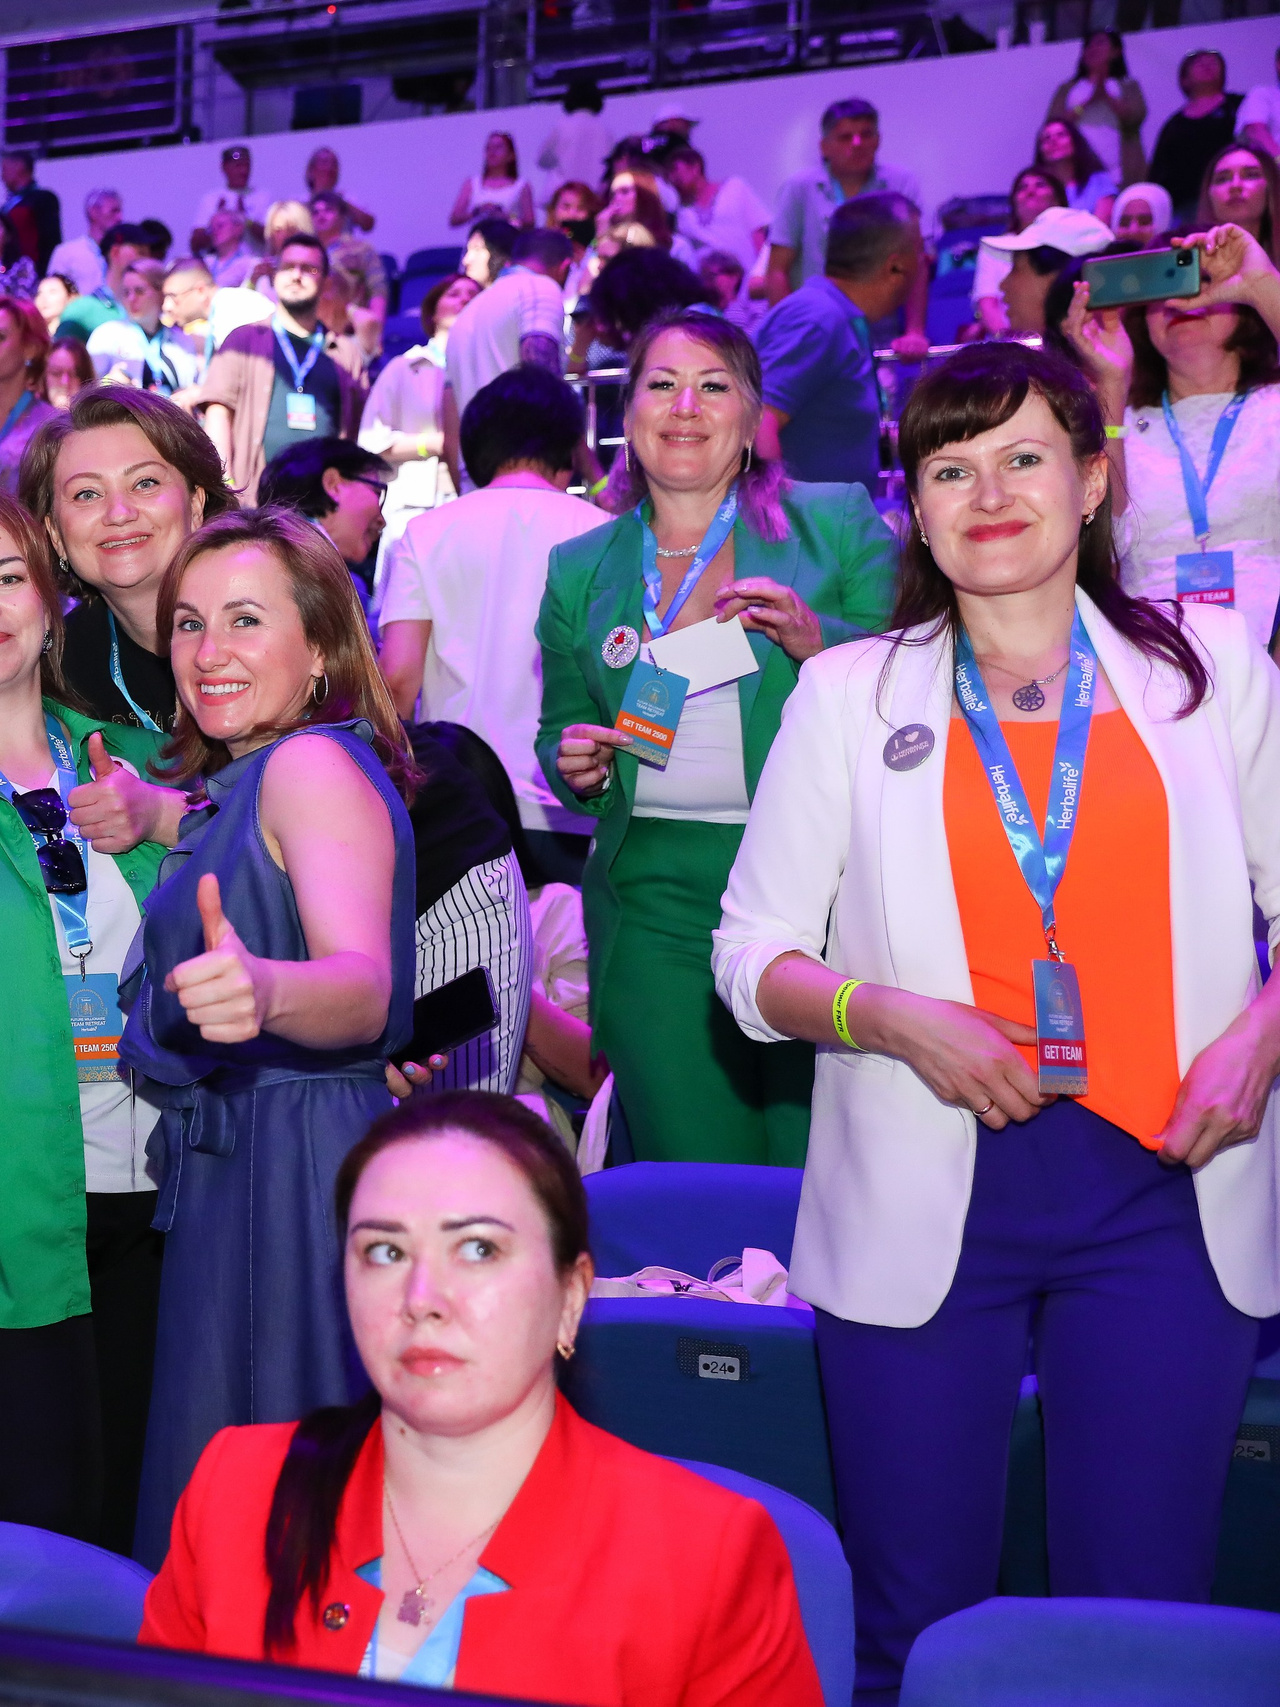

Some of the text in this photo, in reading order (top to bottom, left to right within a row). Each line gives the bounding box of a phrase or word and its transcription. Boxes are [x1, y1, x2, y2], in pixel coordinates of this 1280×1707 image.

[1203, 591, 1229, 602] TEAM
[955, 663, 977, 711] Herbalife
[1075, 657, 1094, 708] Herbalife
[622, 718, 668, 741] GET TEAM 2500
[989, 765, 1017, 823] Herbalife
[1057, 768, 1079, 829] Herbalife
[78, 1044, 100, 1053] TEAM
[1044, 1045, 1083, 1061] GET TEAM
[710, 1361, 728, 1375] 24
[1236, 1445, 1256, 1458] 25
